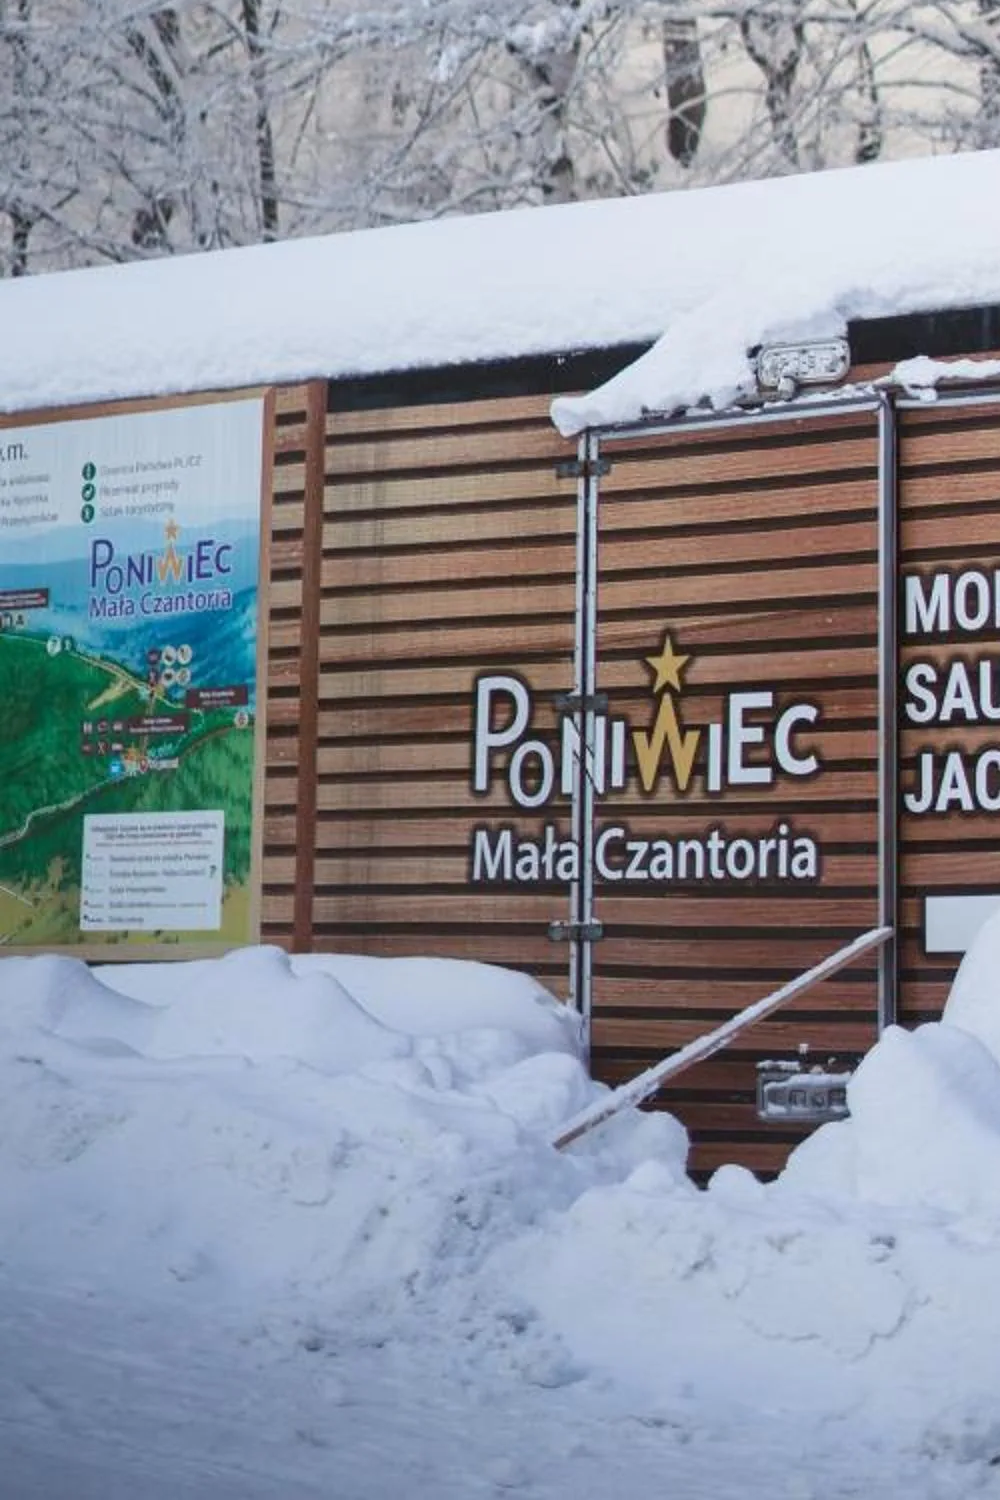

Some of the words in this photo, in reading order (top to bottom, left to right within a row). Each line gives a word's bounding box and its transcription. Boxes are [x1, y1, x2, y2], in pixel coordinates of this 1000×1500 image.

[90, 594, 135, 618] Mała
[140, 590, 232, 615] Czantoria
[473, 675, 819, 807] PONIWIEC
[472, 826, 580, 880] Mała
[595, 823, 817, 880] Czantoria
